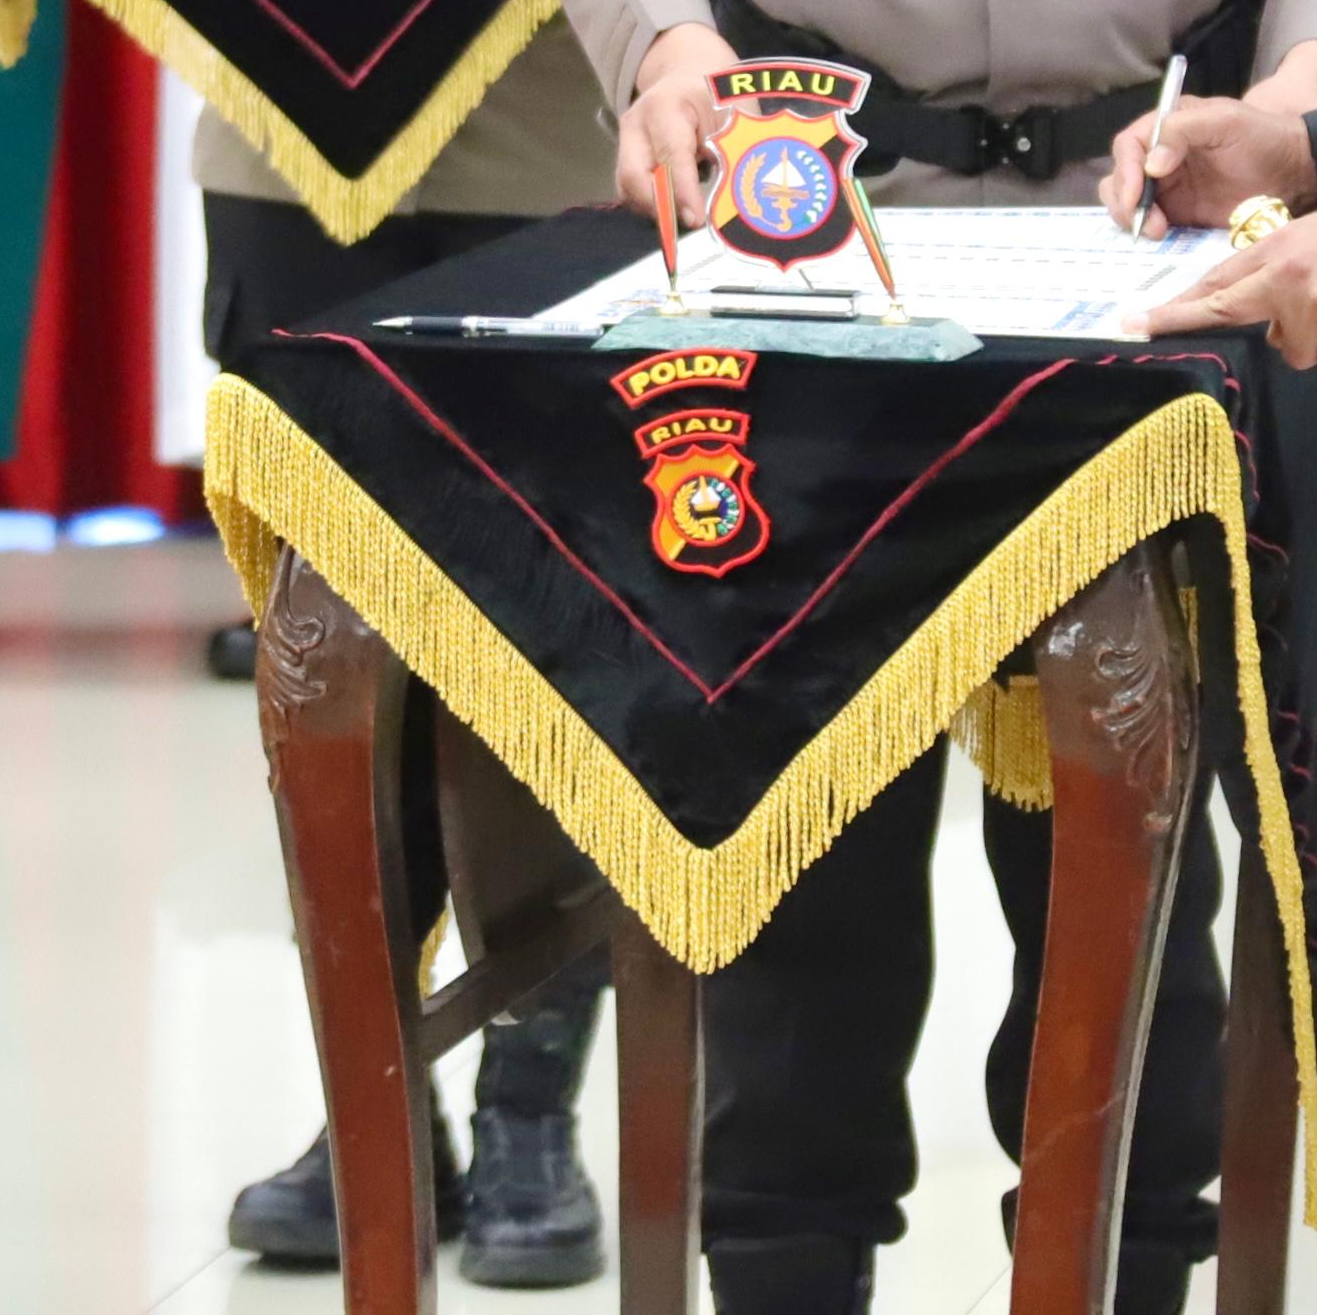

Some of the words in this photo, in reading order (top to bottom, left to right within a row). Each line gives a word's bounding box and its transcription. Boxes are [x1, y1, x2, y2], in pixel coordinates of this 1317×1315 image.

[730, 70, 836, 96] RIAU
[628, 355, 741, 396] POLDA
[651, 416, 733, 445] RIAU
